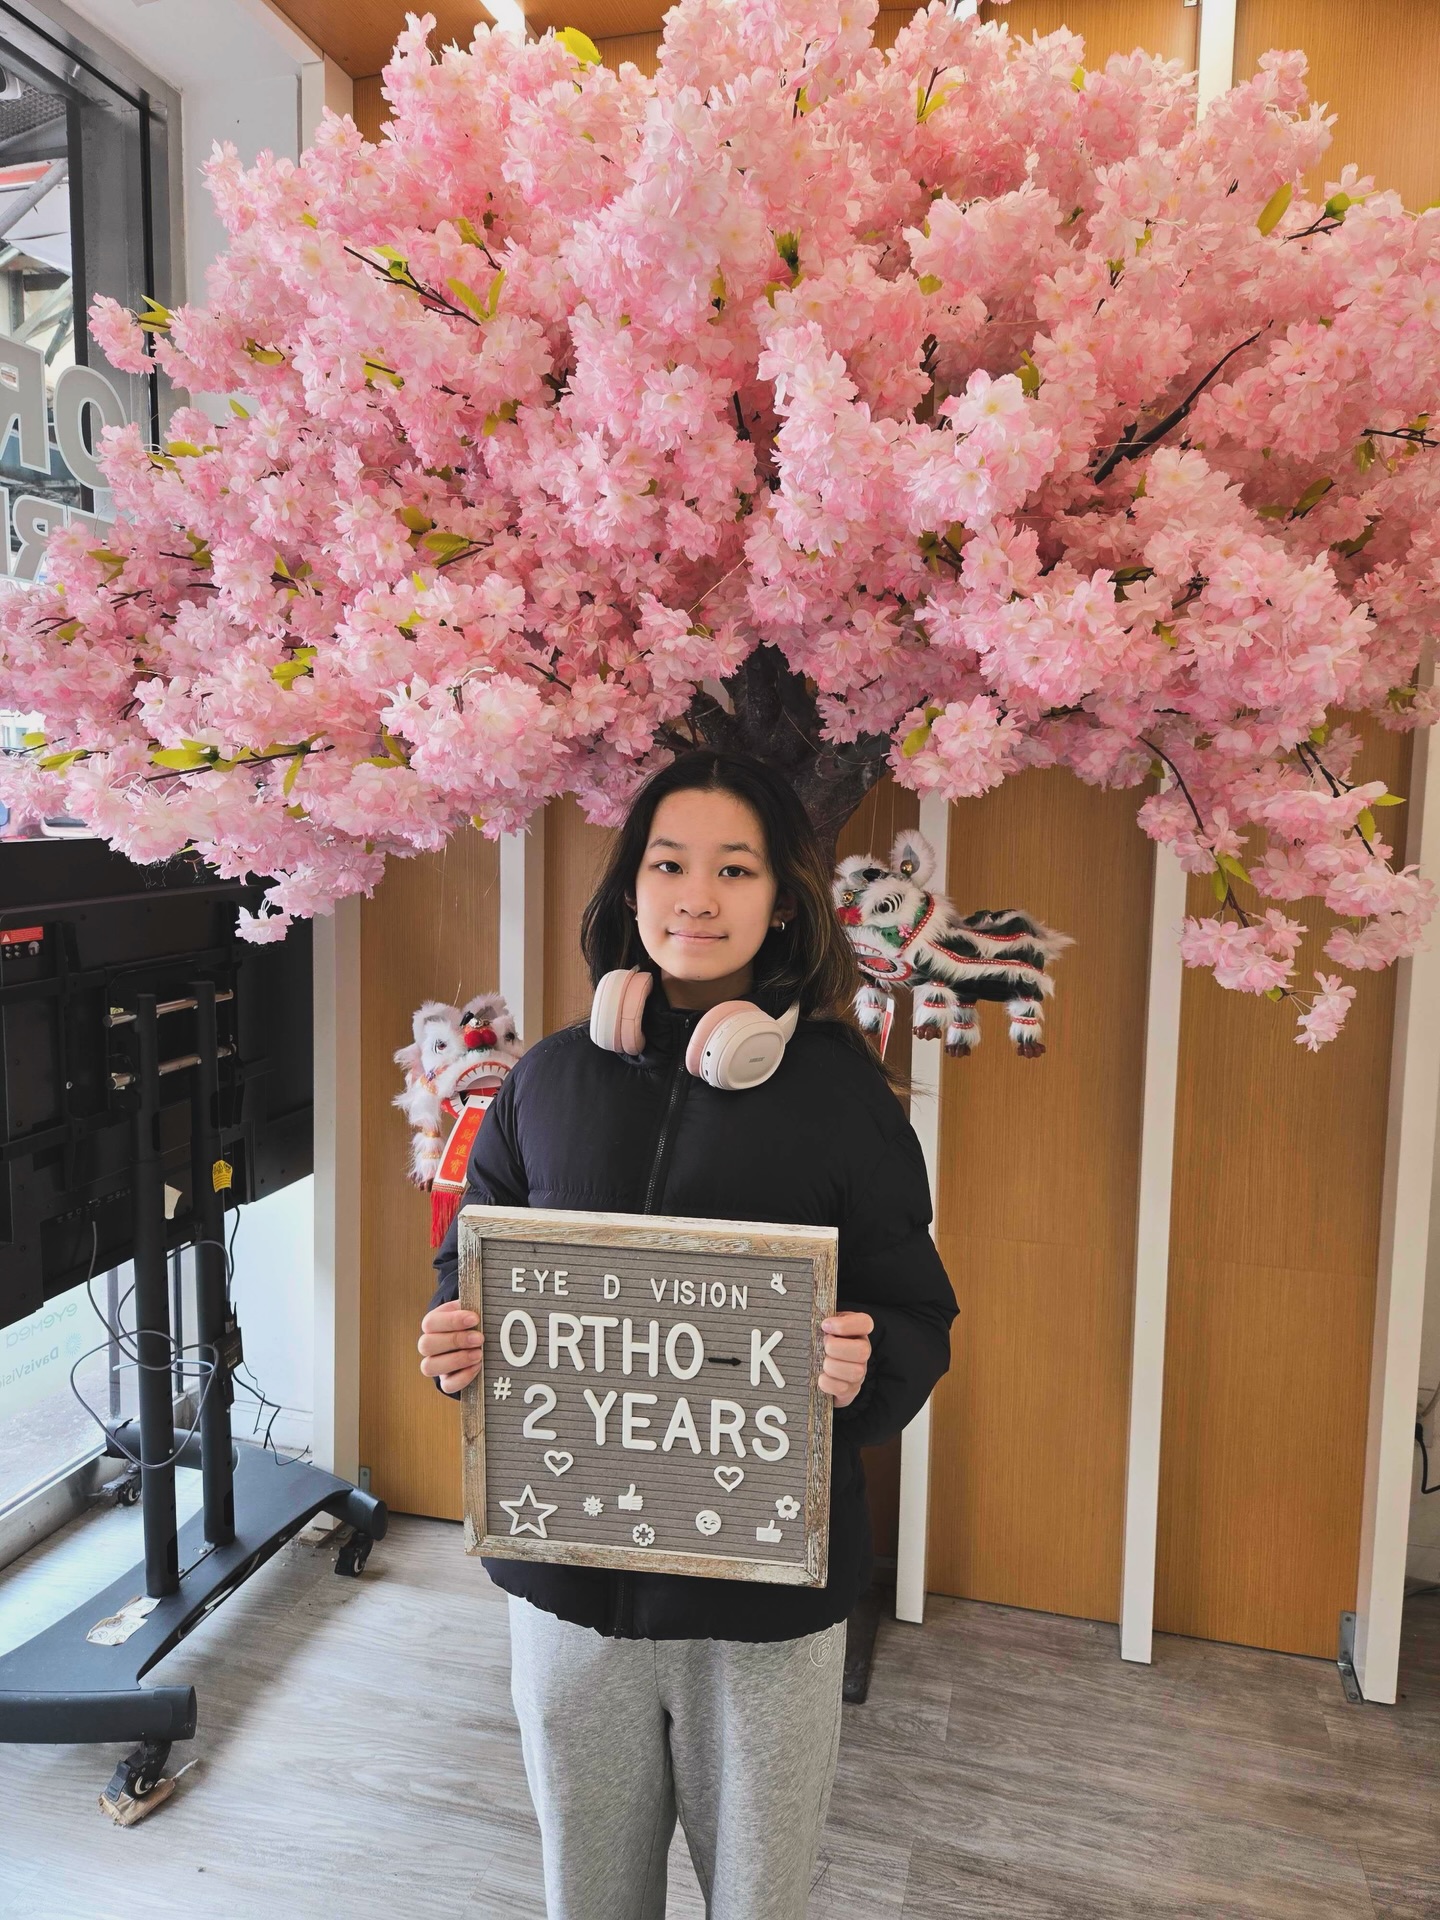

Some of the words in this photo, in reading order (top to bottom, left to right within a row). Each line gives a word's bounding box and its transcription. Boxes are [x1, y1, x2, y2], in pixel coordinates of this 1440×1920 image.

[511, 1267, 569, 1296] EYE
[604, 1274, 620, 1300] D
[650, 1277, 748, 1310] VISION
[583, 1388, 790, 1462] YEARS
